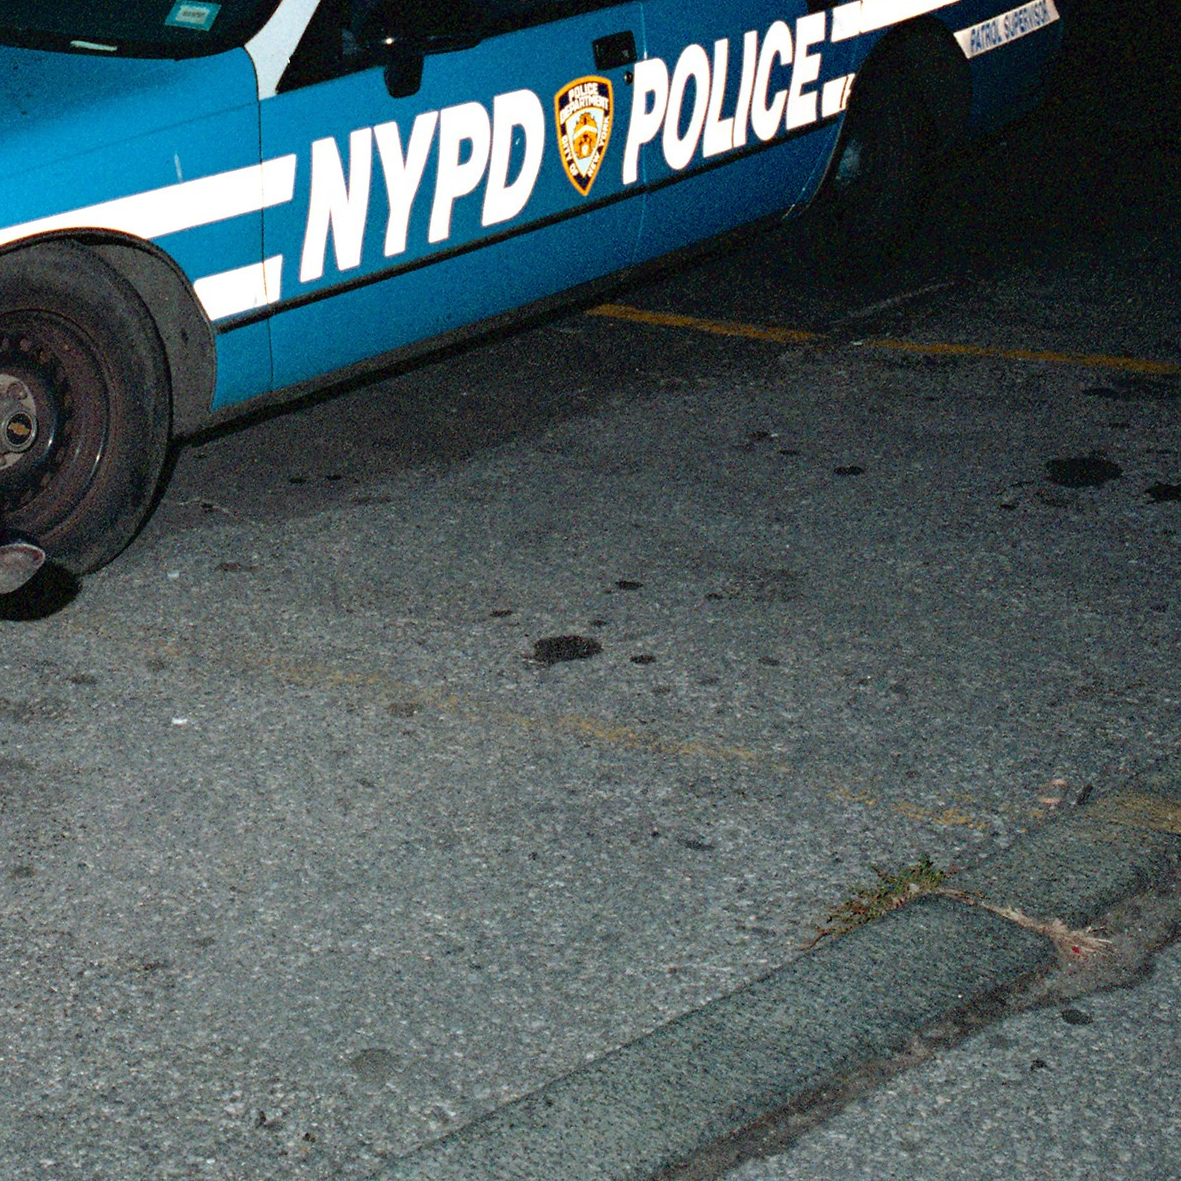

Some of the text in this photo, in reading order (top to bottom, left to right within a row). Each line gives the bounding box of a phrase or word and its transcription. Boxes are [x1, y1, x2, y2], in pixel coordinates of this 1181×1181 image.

[970, 20, 1003, 54] PATROL
[567, 82, 598, 103] POLICE
[559, 94, 609, 125] DEPARTMENT
[299, 11, 827, 284] NYPD POLICE
